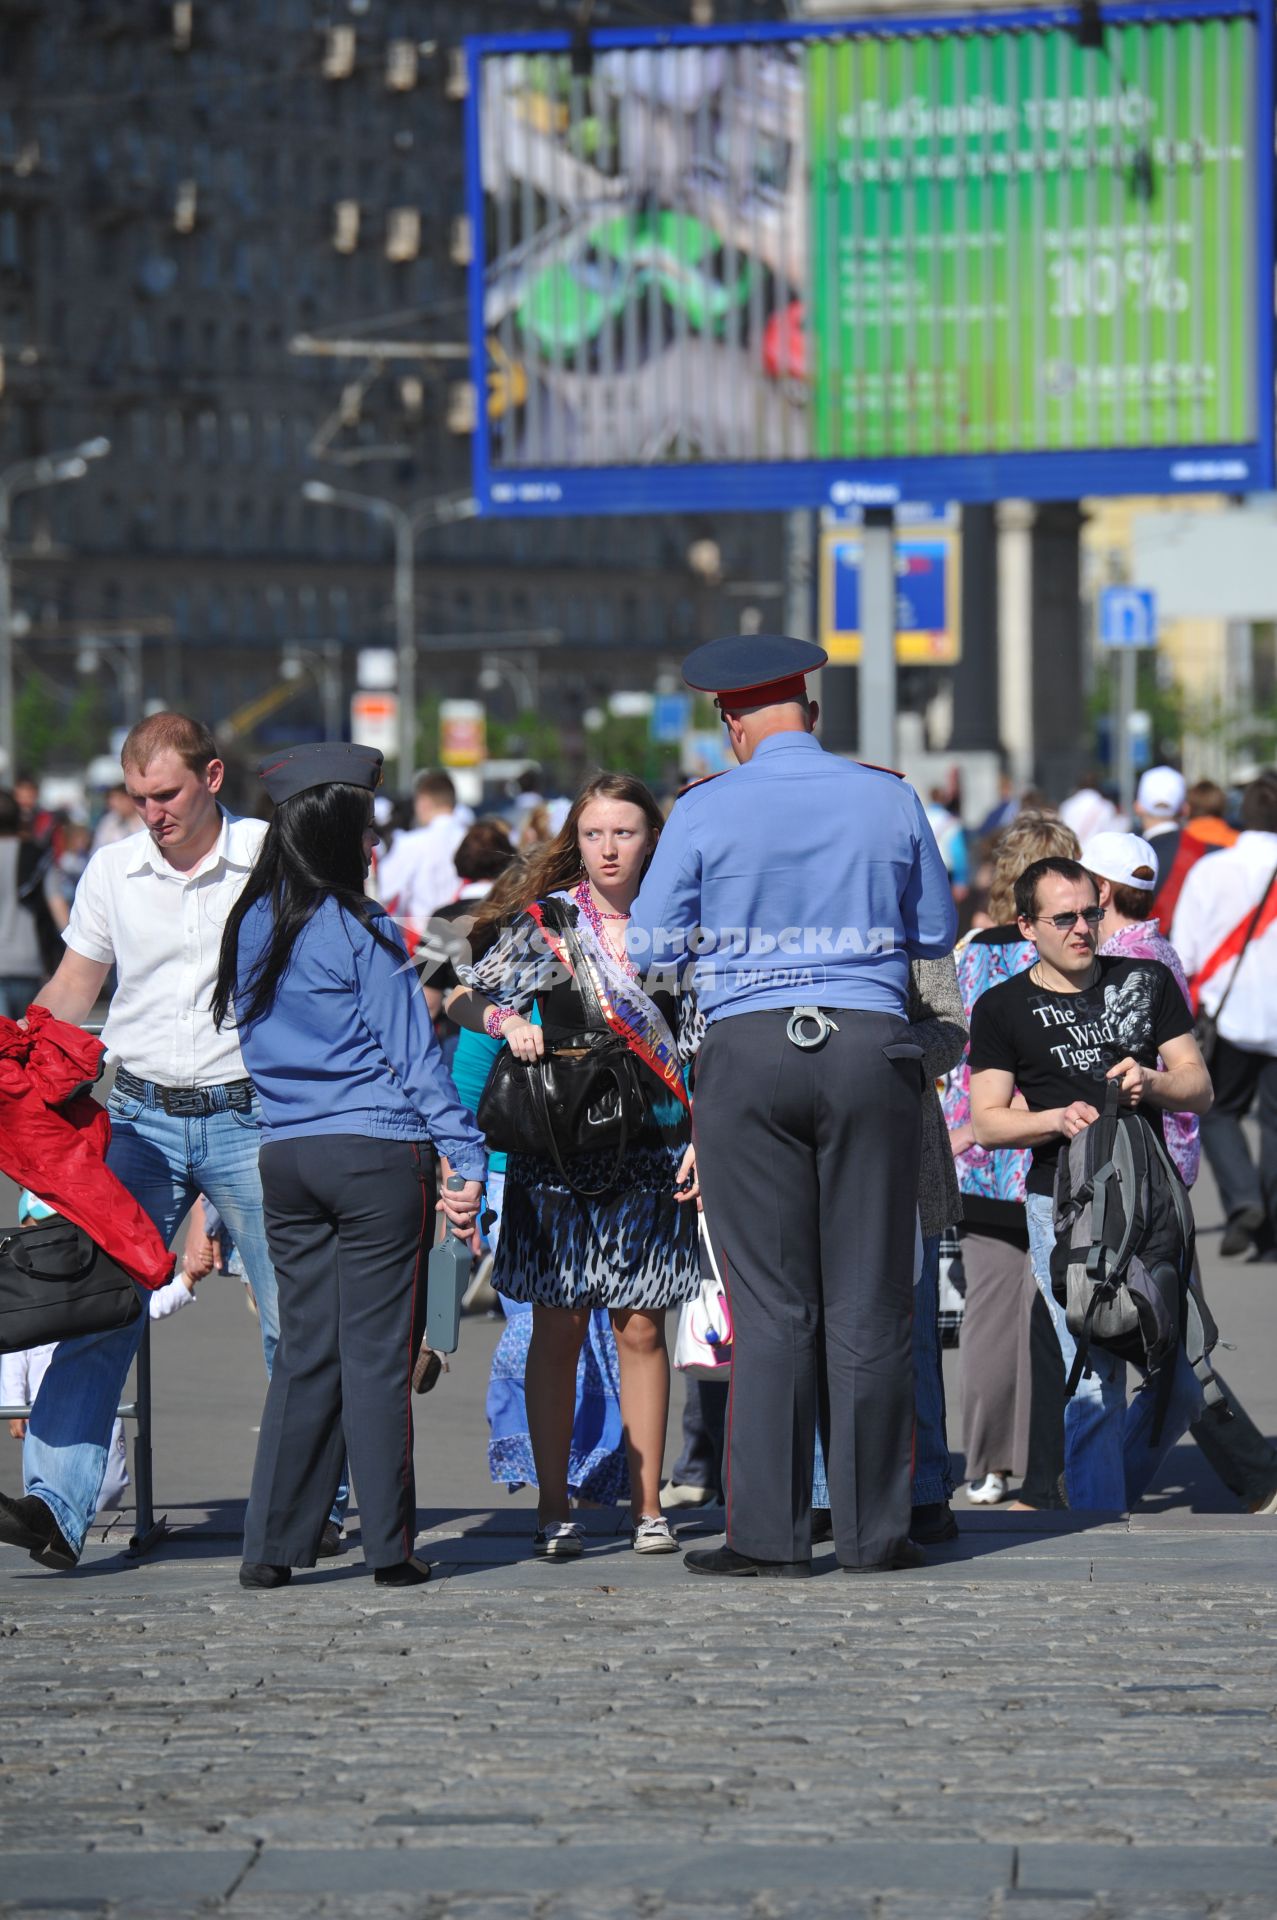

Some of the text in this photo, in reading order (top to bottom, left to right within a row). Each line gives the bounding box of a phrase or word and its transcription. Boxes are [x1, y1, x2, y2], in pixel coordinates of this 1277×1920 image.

[1048, 249, 1188, 316] 10%
[1032, 1004, 1077, 1028] The
[1066, 1019, 1115, 1047] Wild
[1050, 1043, 1102, 1071] Tiger
